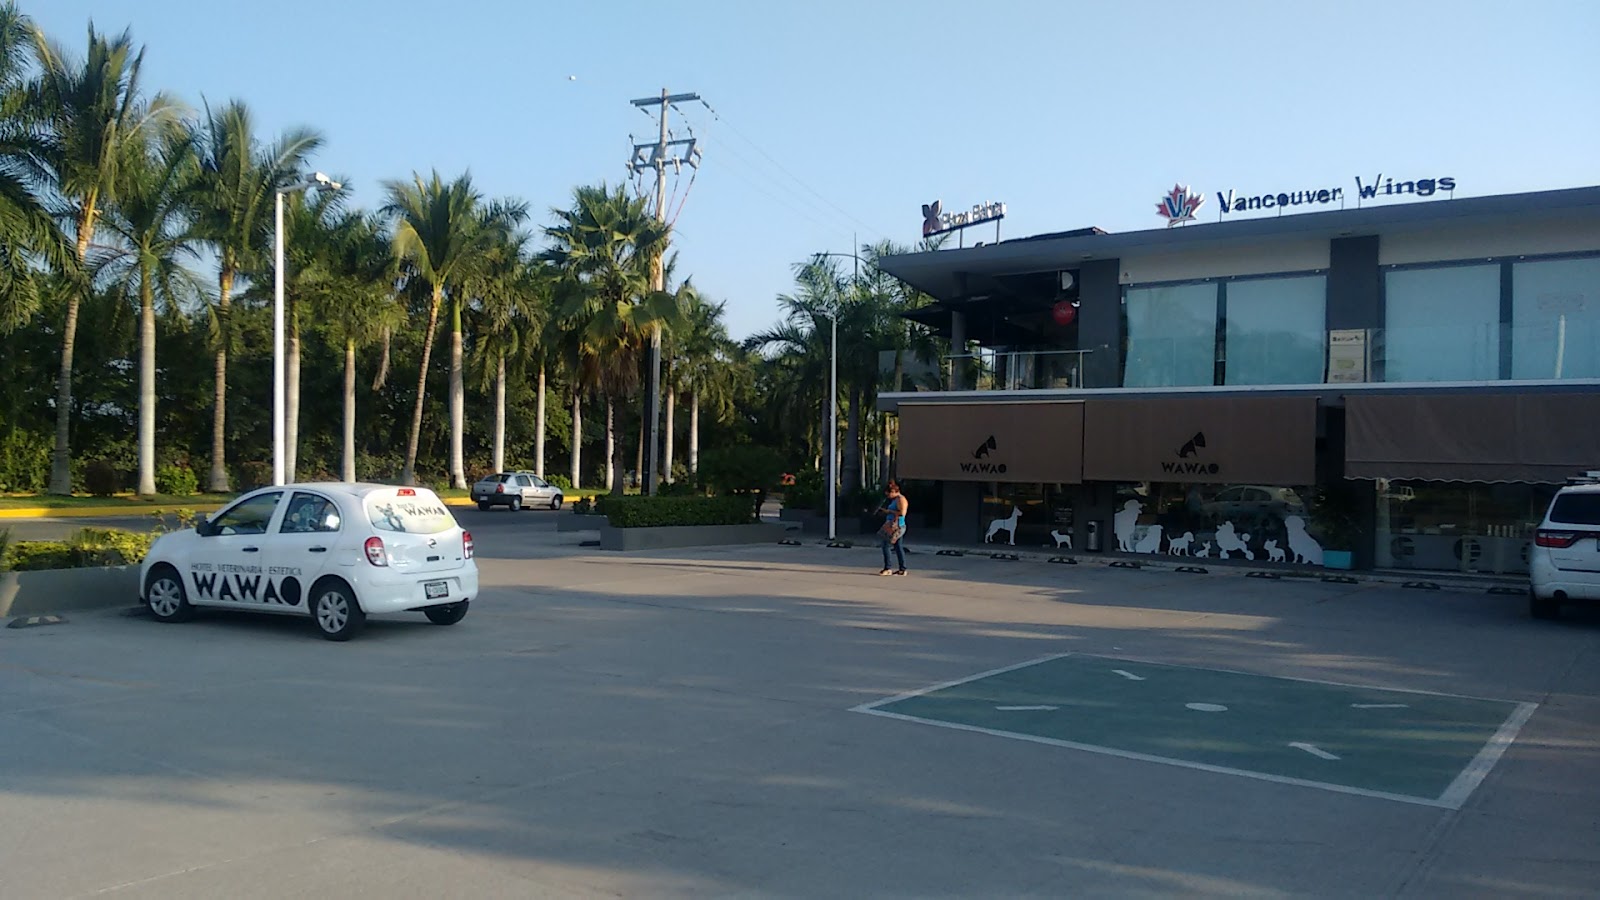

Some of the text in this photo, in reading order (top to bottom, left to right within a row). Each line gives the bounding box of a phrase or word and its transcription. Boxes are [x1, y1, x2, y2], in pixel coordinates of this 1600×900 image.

[1217, 173, 1456, 213] Vancouver Wings
[960, 463, 1007, 474] WAWAO
[1161, 462, 1219, 475] WAWAO
[404, 506, 446, 516] WAWAO
[191, 563, 212, 571] HOTEL
[217, 564, 262, 574] VETERINARIA
[191, 572, 302, 606] WAWAO
